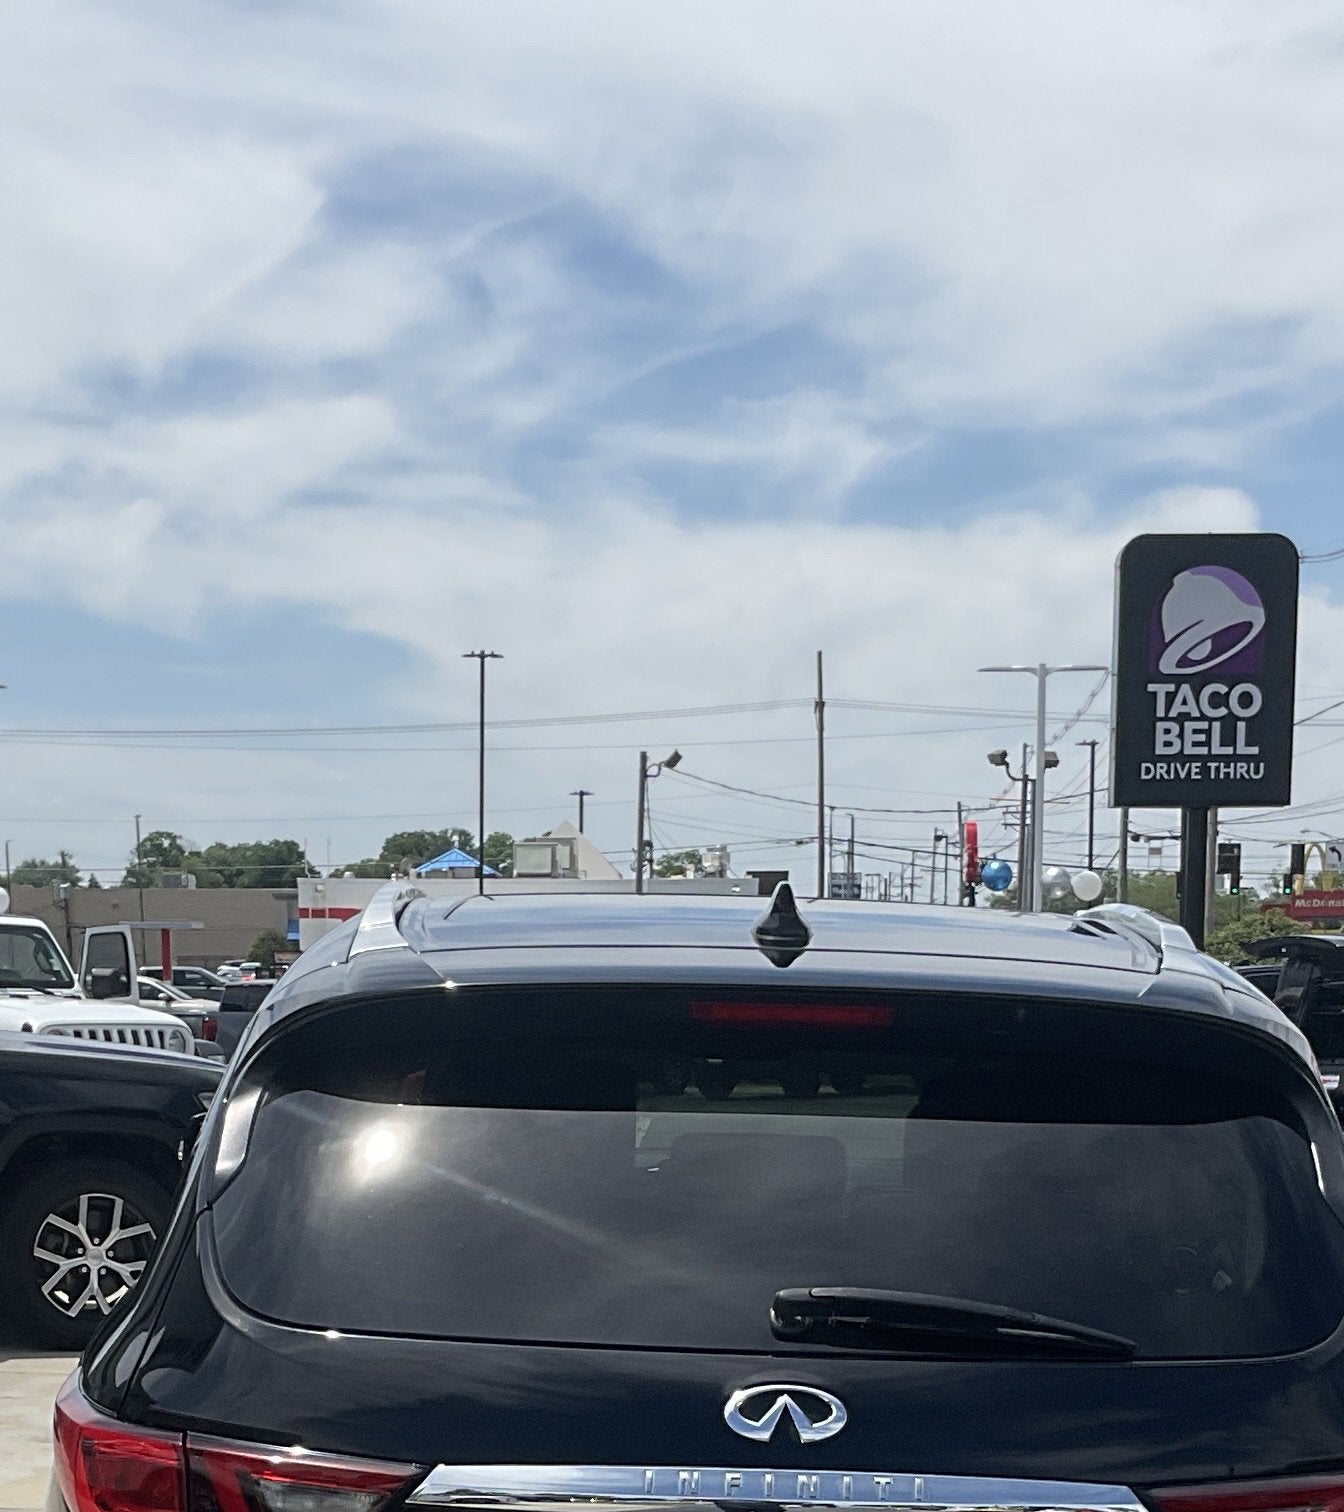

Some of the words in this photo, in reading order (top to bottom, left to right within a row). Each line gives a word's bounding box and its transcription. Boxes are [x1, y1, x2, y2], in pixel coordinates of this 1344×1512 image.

[1146, 682, 1263, 718] TACO
[1155, 720, 1259, 755] BELL
[1140, 762, 1202, 780] DRIVE
[1206, 762, 1265, 780] THRU
[644, 1469, 925, 1501] INFINITI
